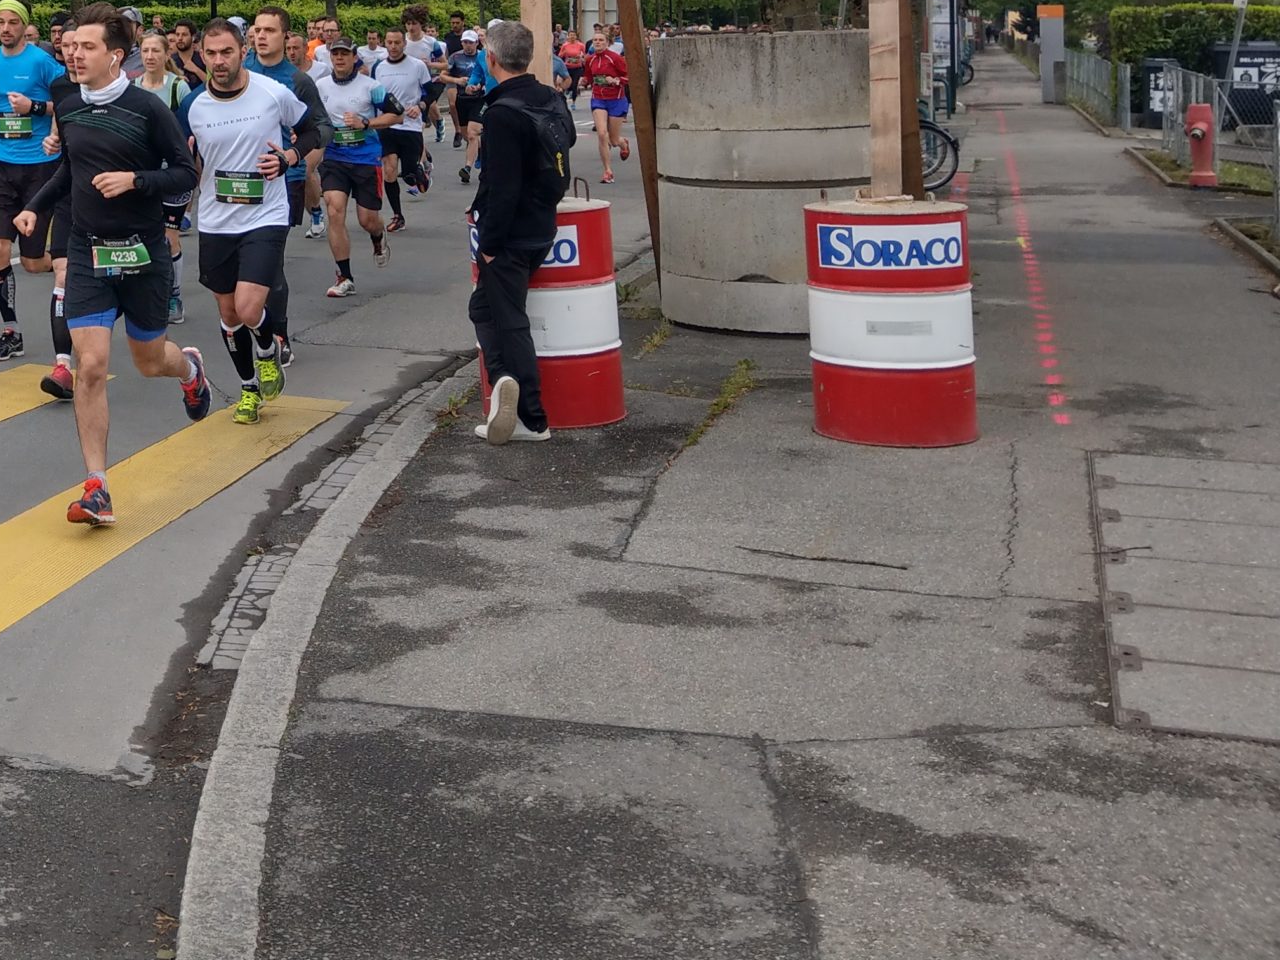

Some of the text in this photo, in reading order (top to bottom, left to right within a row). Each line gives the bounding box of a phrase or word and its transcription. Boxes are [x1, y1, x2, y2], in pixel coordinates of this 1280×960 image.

[206, 115, 262, 129] RICHEMONT
[827, 227, 961, 267] SORACO
[110, 250, 138, 263] 4238
